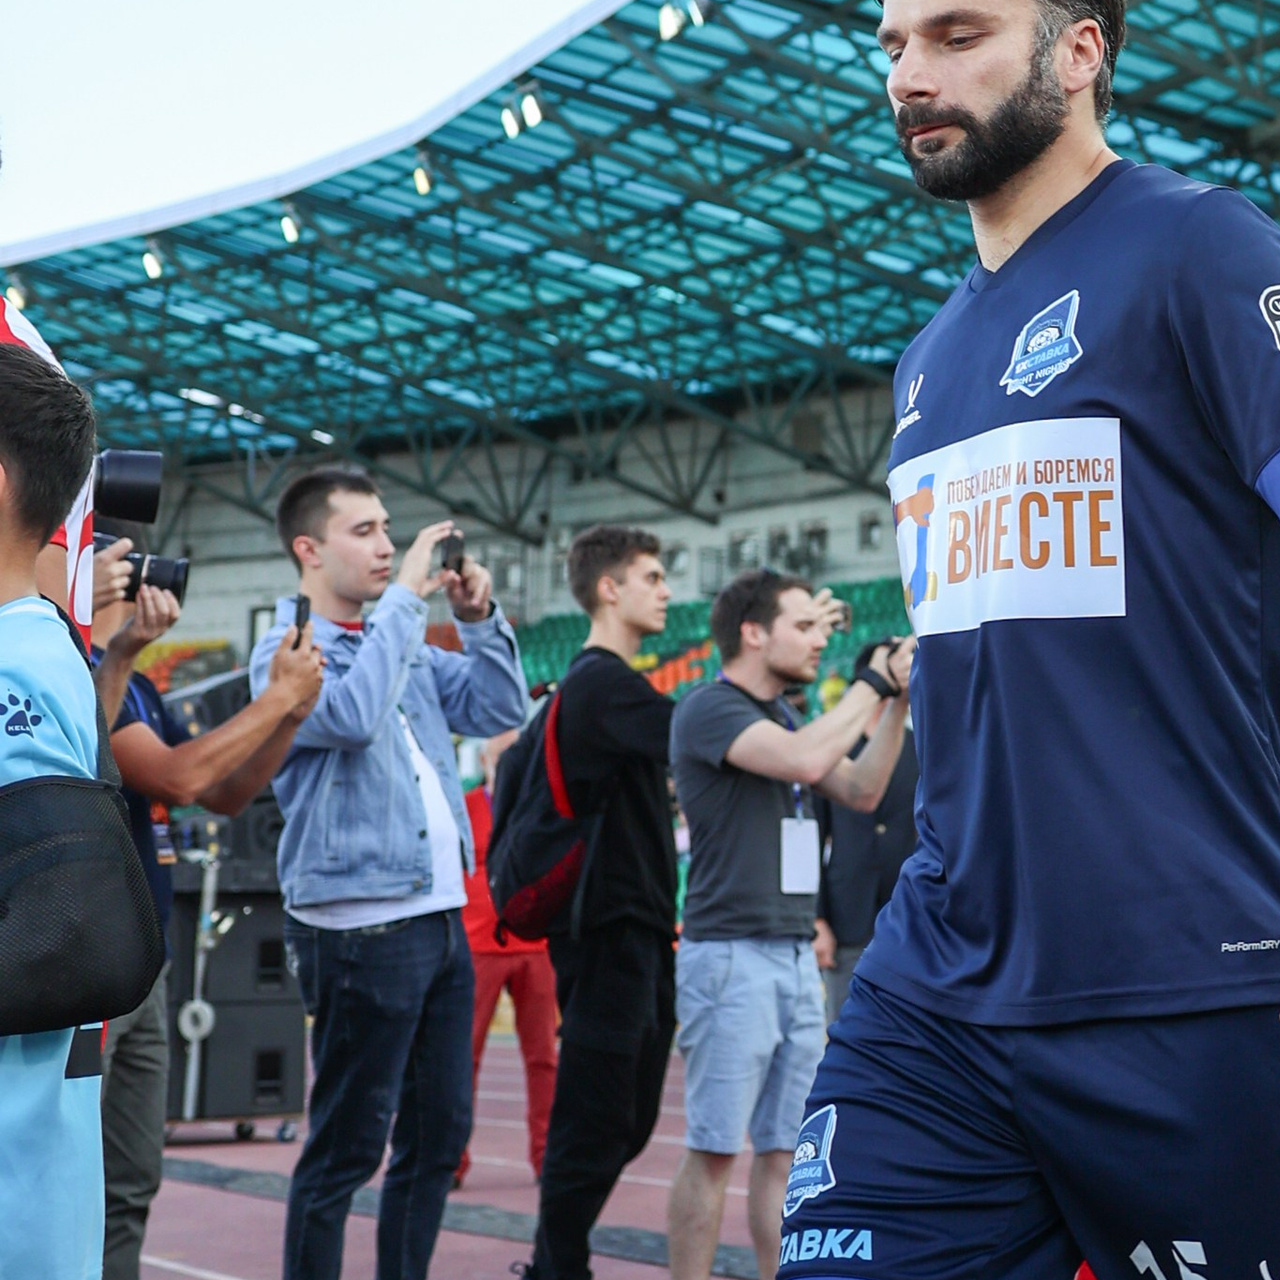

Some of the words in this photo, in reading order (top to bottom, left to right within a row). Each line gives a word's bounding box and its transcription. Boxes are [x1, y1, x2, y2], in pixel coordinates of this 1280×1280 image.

[1016, 461, 1027, 485] И
[1034, 458, 1115, 485] БОРЕМСЯ
[947, 489, 1118, 585] ВМЕСТЕ
